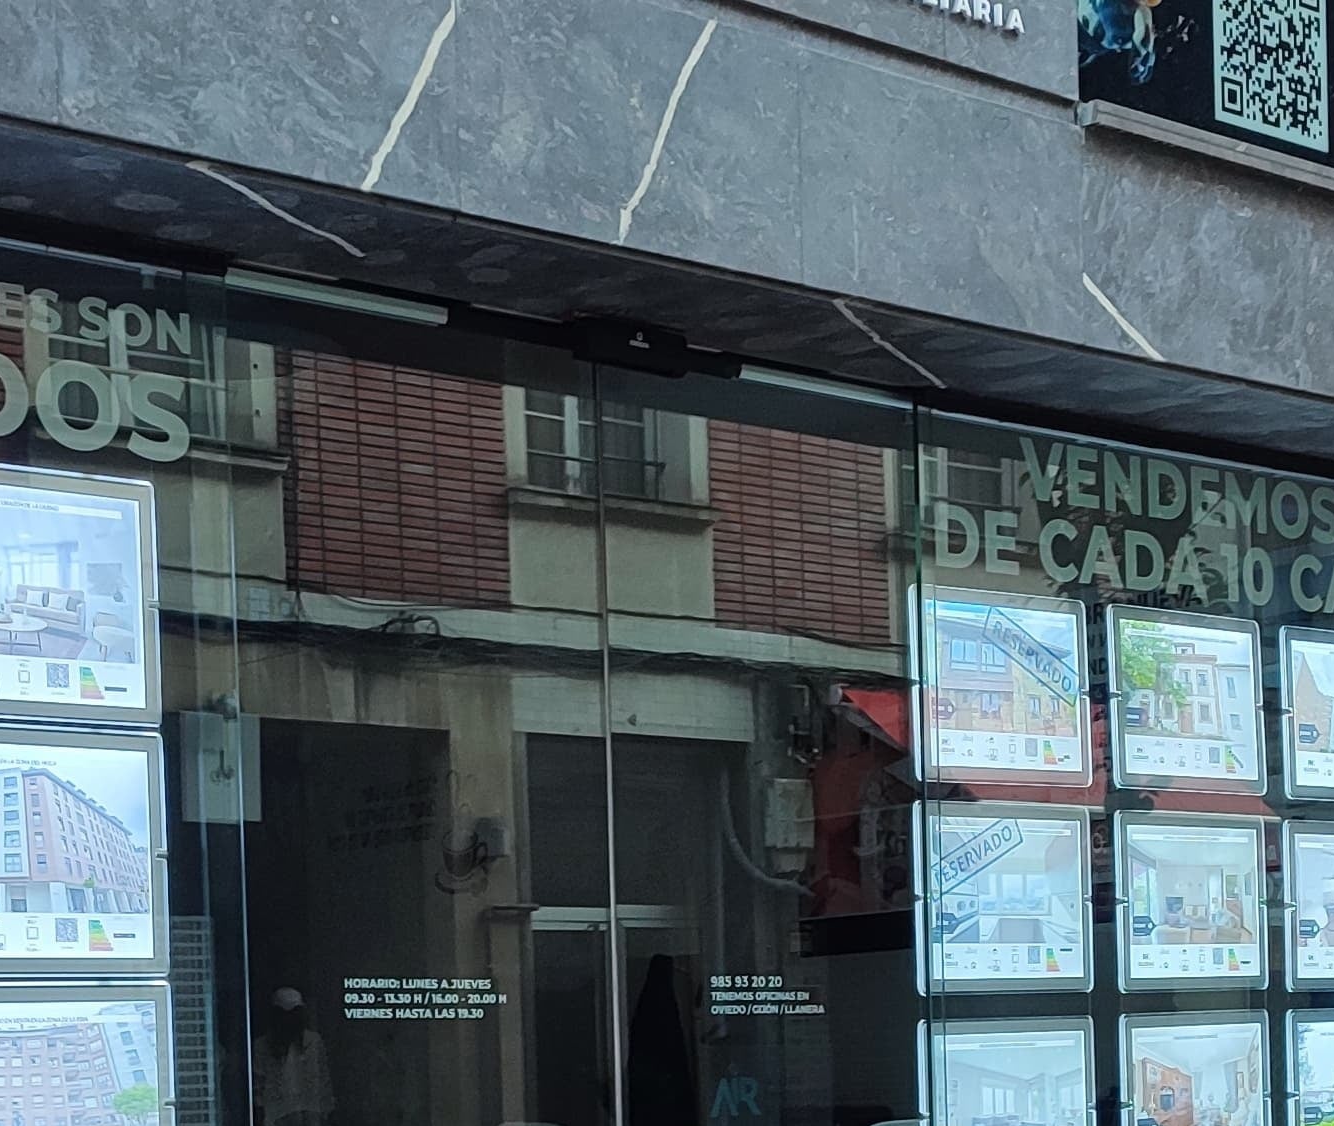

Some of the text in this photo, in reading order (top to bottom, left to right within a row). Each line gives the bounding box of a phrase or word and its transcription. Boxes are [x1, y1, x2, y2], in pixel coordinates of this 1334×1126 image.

[78, 295, 192, 356] SON
[934, 502, 1020, 578] DE
[1038, 517, 1209, 606] CADA
[1220, 543, 1275, 607] 10
[992, 619, 1073, 694] RESERVADO
[343, 977, 400, 990] HORARIO:
[402, 977, 439, 990] LUNES
[449, 978, 492, 990] JUEVES
[710, 975, 783, 988] 985 93 20 20
[413, 993, 423, 1004] H
[467, 993, 497, 1004] 20.00
[498, 993, 507, 1004] H
[710, 991, 810, 1001] TENEMOS OFICINAS EN
[344, 1008, 394, 1019] VIERNES
[395, 1008, 433, 1019] HASTA
[434, 1008, 456, 1019] LAS
[710, 1004, 747, 1015] OVIEDO
[784, 1004, 826, 1014] LLANERA
